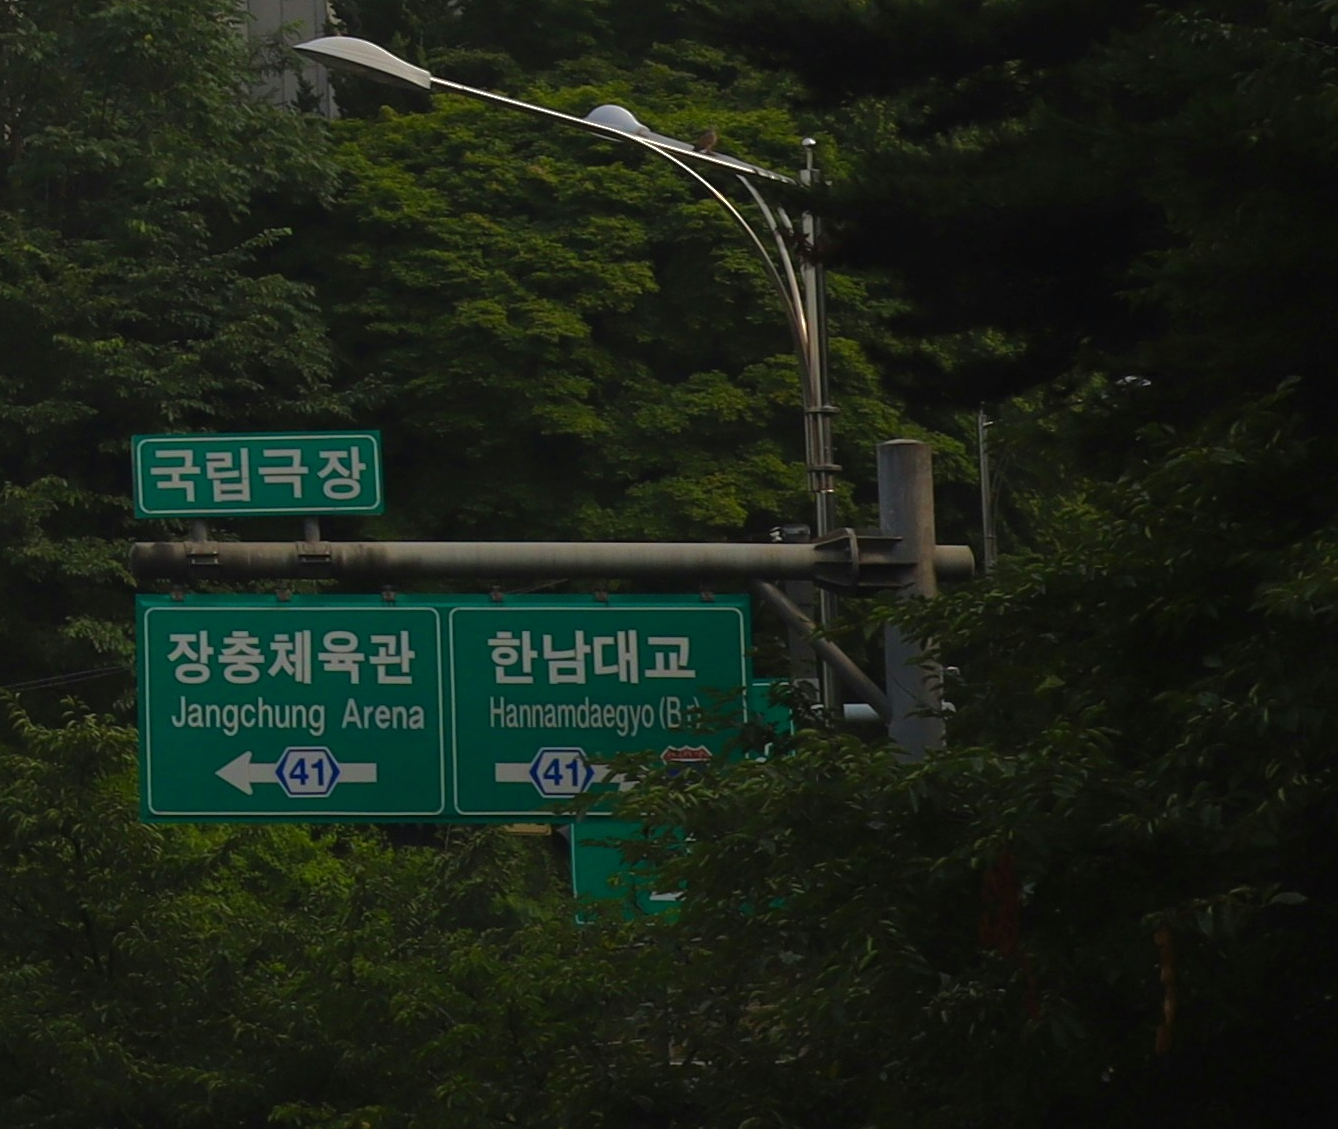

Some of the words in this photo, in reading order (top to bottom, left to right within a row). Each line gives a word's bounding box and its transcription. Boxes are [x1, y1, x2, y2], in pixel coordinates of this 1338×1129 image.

[150, 446, 366, 502] 국립극장
[167, 630, 415, 684] 장충체육관
[487, 630, 696, 684] 한남대교
[171, 696, 325, 736] Jangchung
[341, 698, 424, 729] Arena
[289, 758, 324, 785] 41
[543, 758, 579, 786] 41
